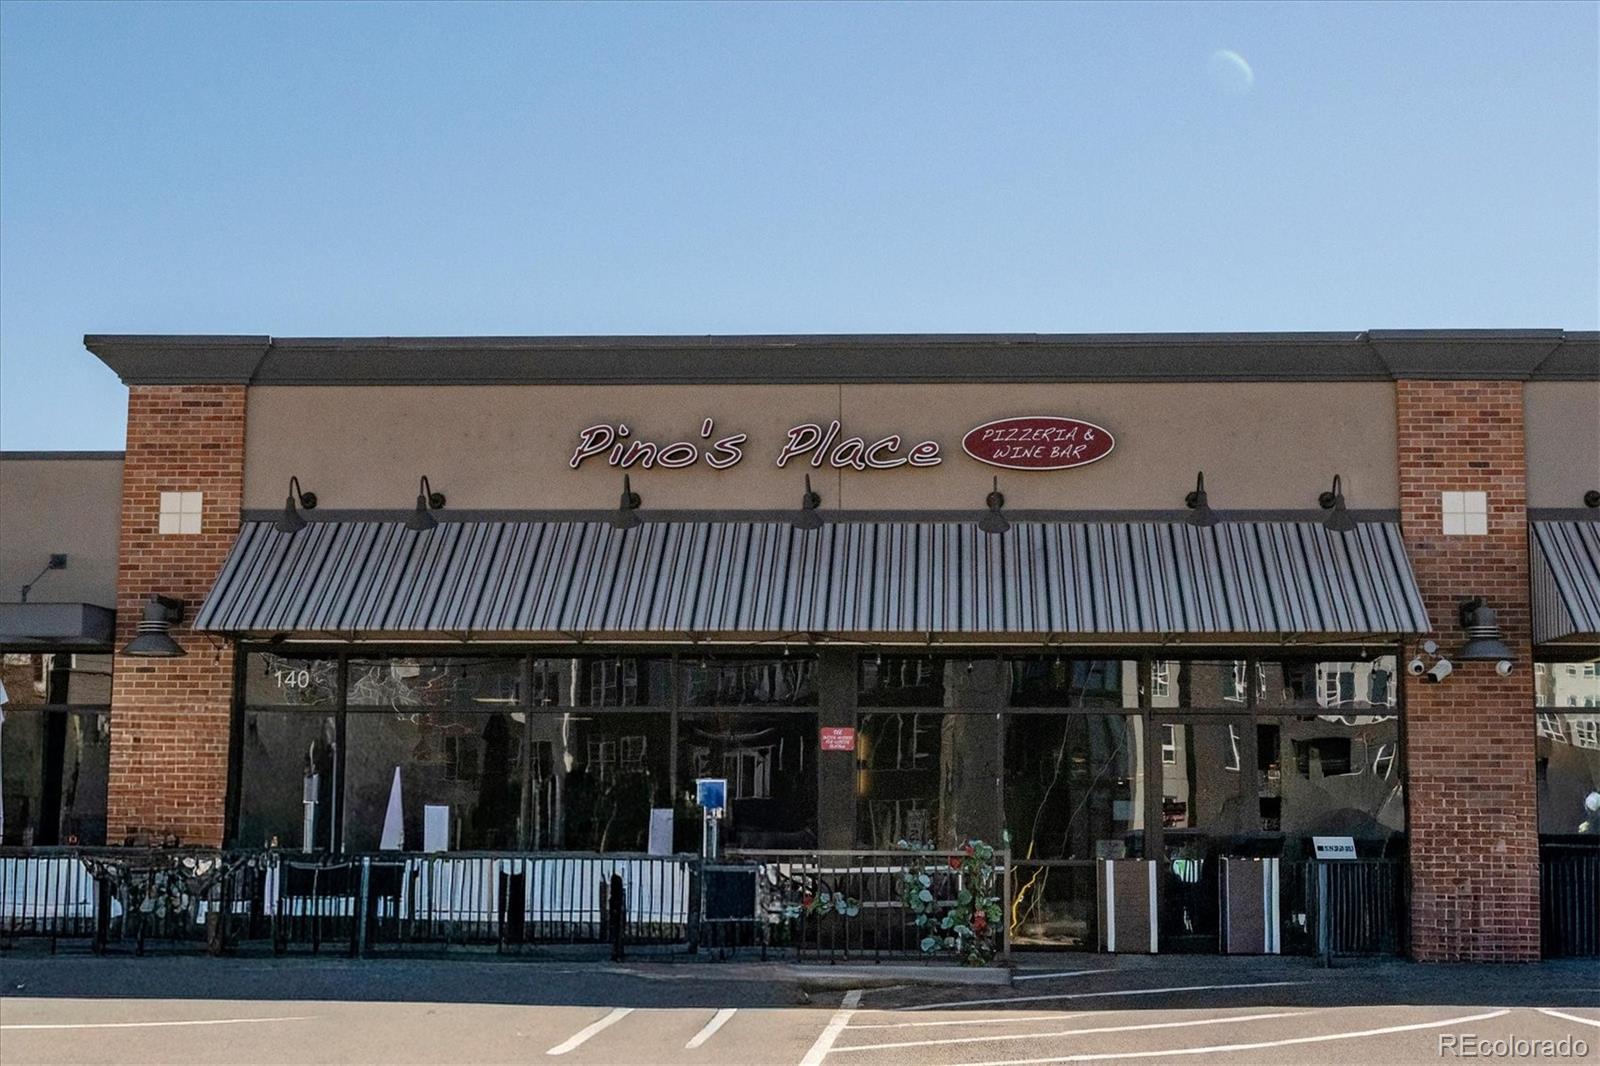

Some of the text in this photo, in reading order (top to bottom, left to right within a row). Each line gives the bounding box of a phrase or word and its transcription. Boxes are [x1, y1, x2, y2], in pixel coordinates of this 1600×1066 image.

[982, 427, 1095, 441] PIZZERIA &
[569, 417, 942, 470] Pino's Place
[993, 444, 1087, 459] WINE BAR
[274, 670, 309, 688] 140
